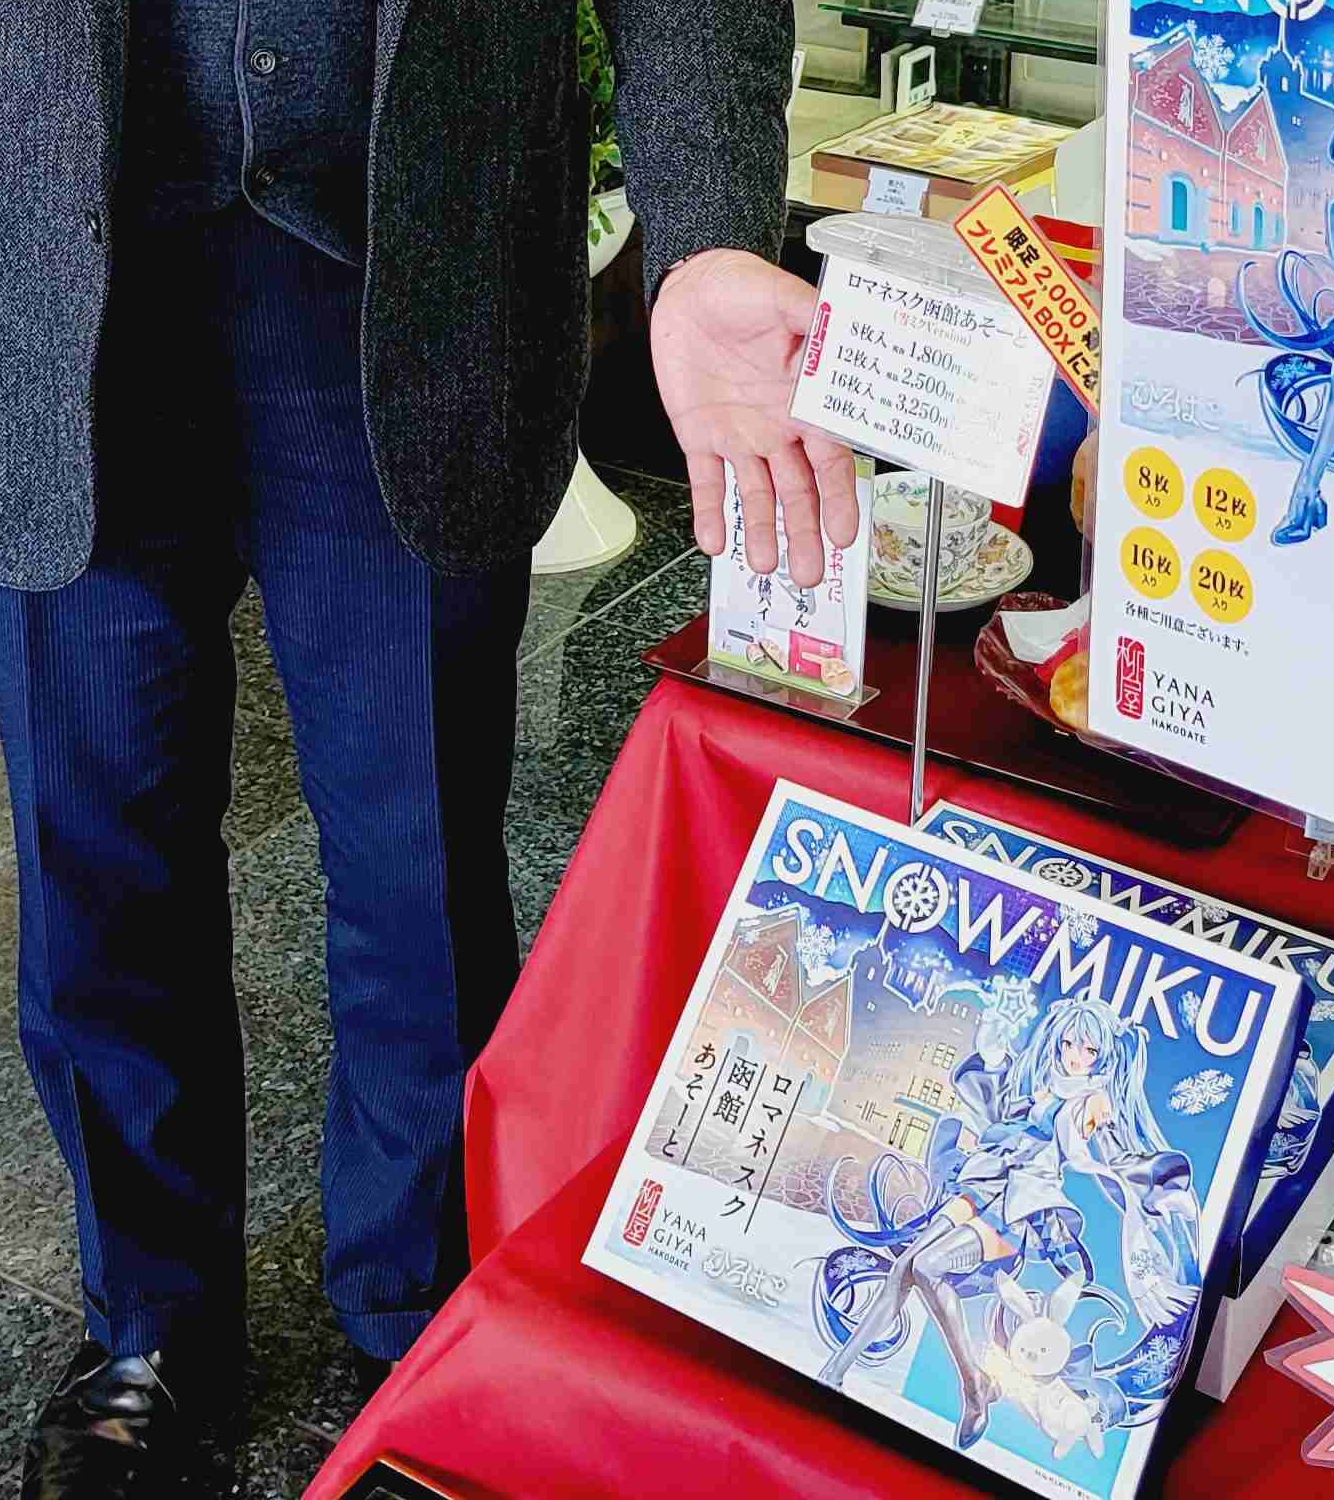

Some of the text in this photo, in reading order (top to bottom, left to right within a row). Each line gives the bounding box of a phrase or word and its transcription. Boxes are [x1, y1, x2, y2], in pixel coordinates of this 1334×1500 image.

[848, 274, 1029, 349] ロマネスク函館あそーと
[851, 322, 888, 349] 8枚入
[836, 345, 882, 376] 12枚入
[829, 370, 875, 401] 16枚入
[823, 394, 869, 425] 20枚入
[1138, 465, 1247, 518] 8枚 12枚
[1145, 493, 1232, 530] 入り 入り
[1131, 543, 1245, 600] 16枚 20枚
[1141, 574, 1229, 611] 入り 入り
[1152, 670, 1215, 708] YANA
[1151, 695, 1205, 728] GIYA
[1151, 717, 1208, 745] HAKODATE
[771, 817, 1262, 1056] SNOW MIKU
[662, 1043, 716, 1158] あそーと
[713, 1056, 758, 1126] 函館
[720, 1073, 793, 1218] ロマネスク
[662, 1207, 708, 1243] YANA
[653, 1229, 694, 1259] GIYA
